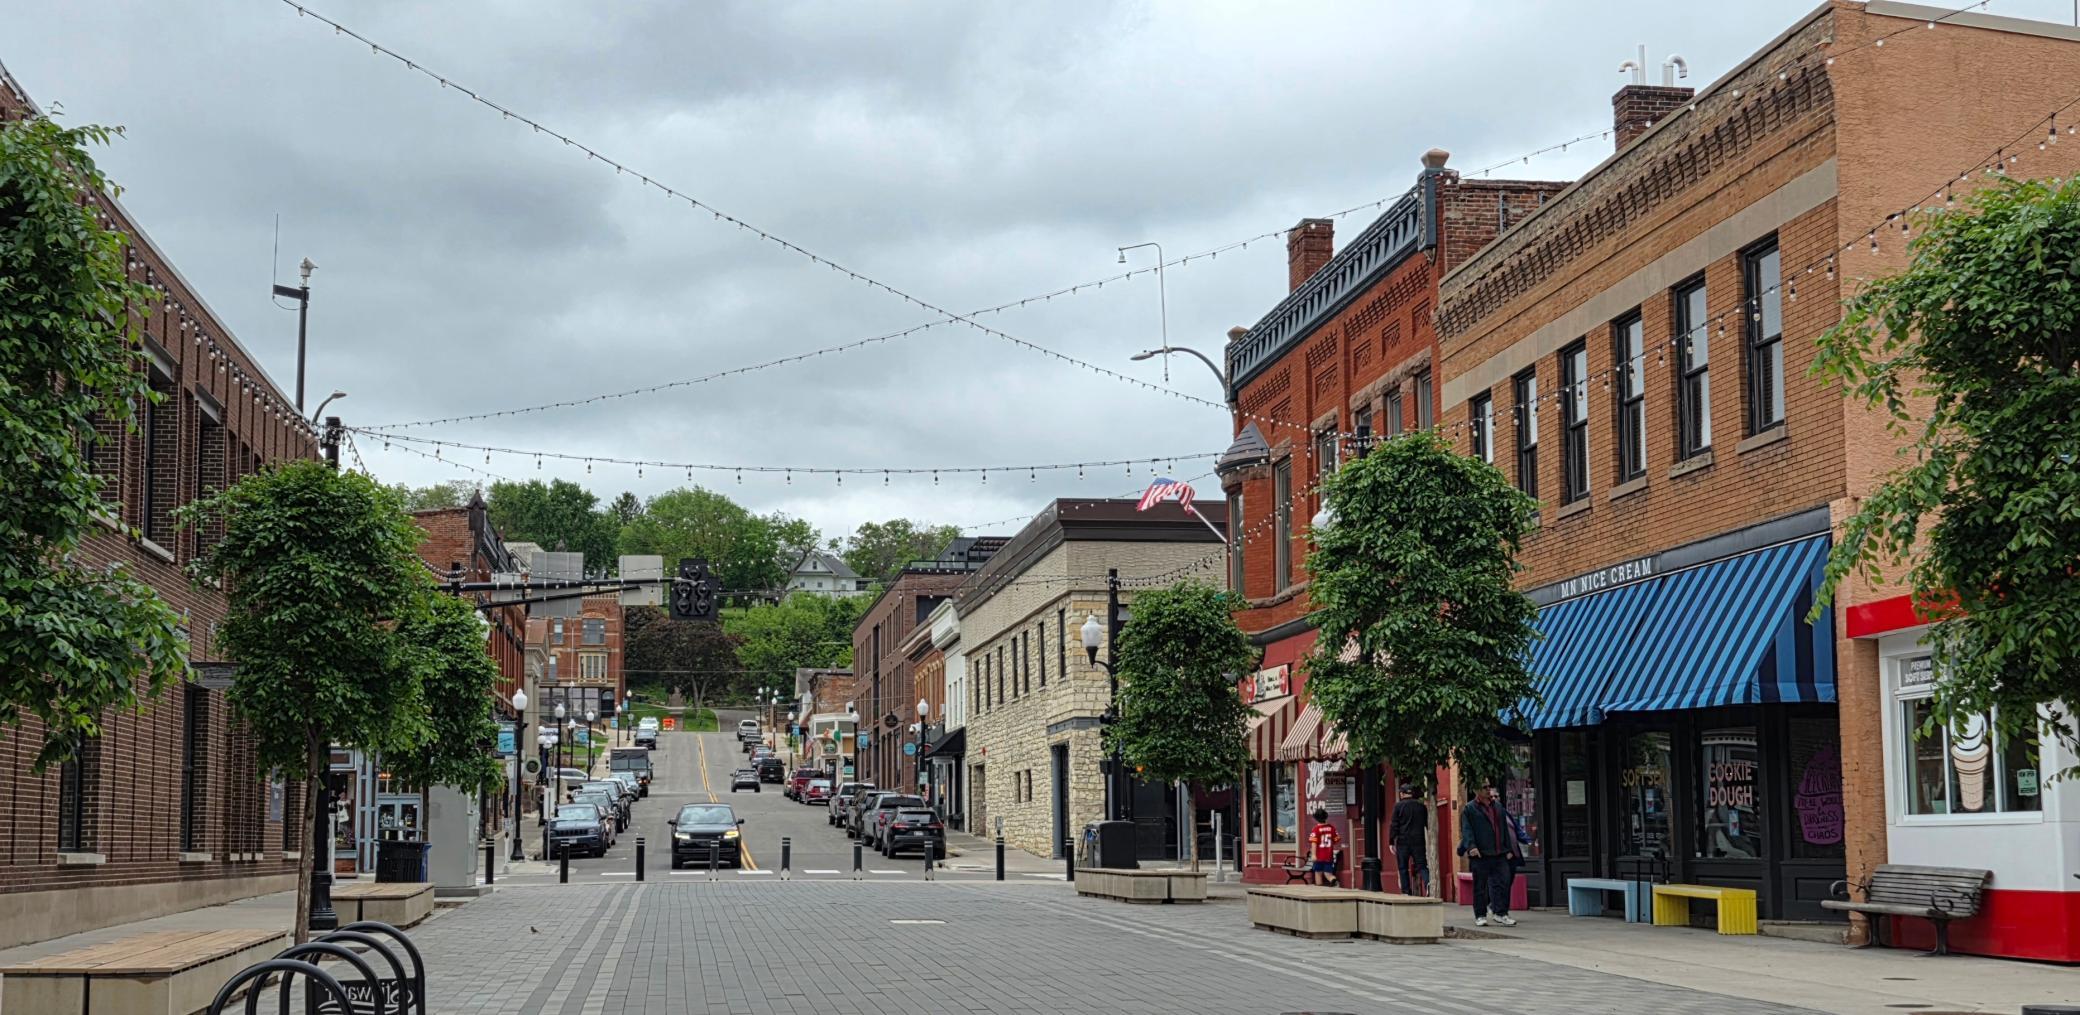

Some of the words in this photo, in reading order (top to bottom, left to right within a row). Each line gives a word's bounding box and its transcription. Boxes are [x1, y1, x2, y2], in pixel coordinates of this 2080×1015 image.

[1561, 579, 1577, 598] MN
[1581, 570, 1607, 593] NICE
[1611, 558, 1652, 584] CREAM
[1709, 763, 1752, 782] COOKIE
[1710, 785, 1752, 806] DOUGH
[1319, 834, 1332, 848] 15
[1808, 829, 1839, 840] CHAOS
